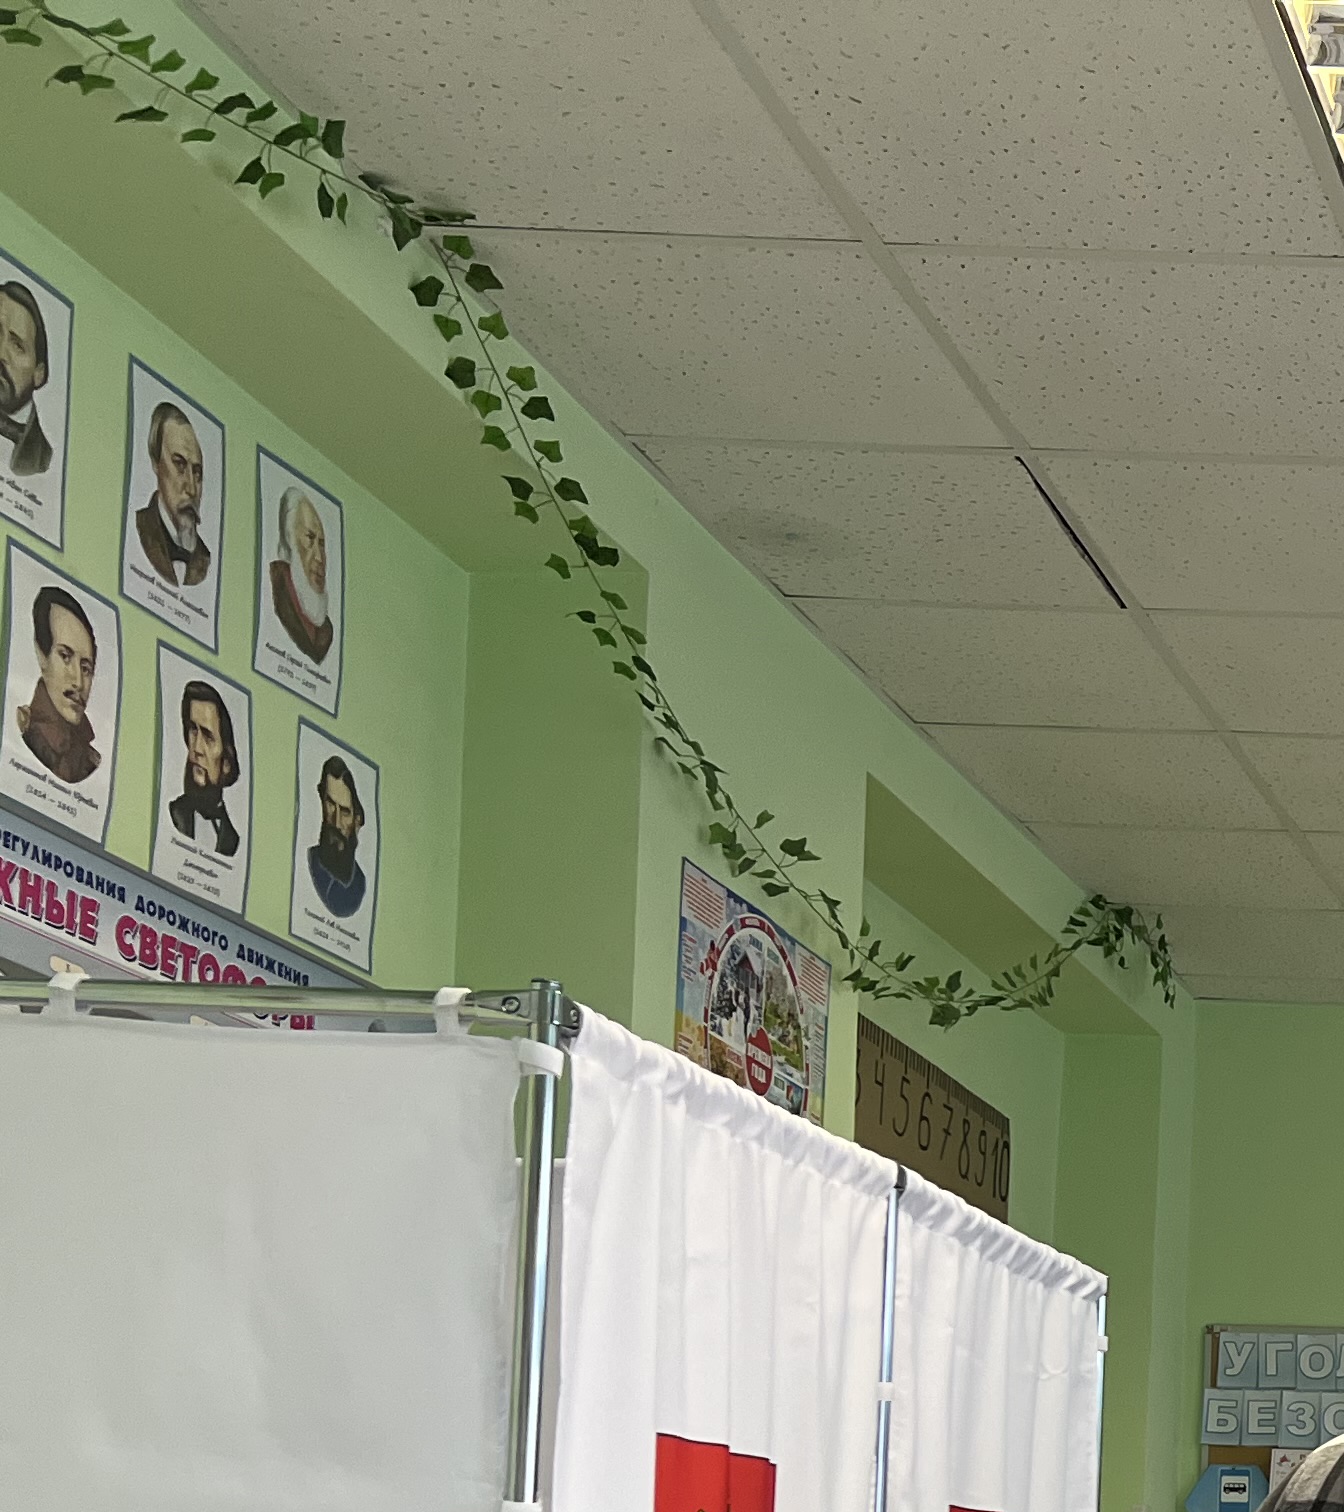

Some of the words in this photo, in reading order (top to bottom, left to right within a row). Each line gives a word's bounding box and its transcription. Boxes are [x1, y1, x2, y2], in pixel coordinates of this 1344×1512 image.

[0, 828, 126, 904] ЕГУЛИРОВАНИЯ
[134, 895, 229, 951] ДОРОЖНОГО
[236, 943, 310, 987] ДВИЖЕНИЯ
[874, 1060, 886, 1125] 4
[892, 1075, 911, 1137] 5
[918, 1091, 933, 1151] 6
[940, 1103, 954, 1161] 7
[975, 1129, 987, 1188] 9
[991, 1137, 1010, 1203] 10
